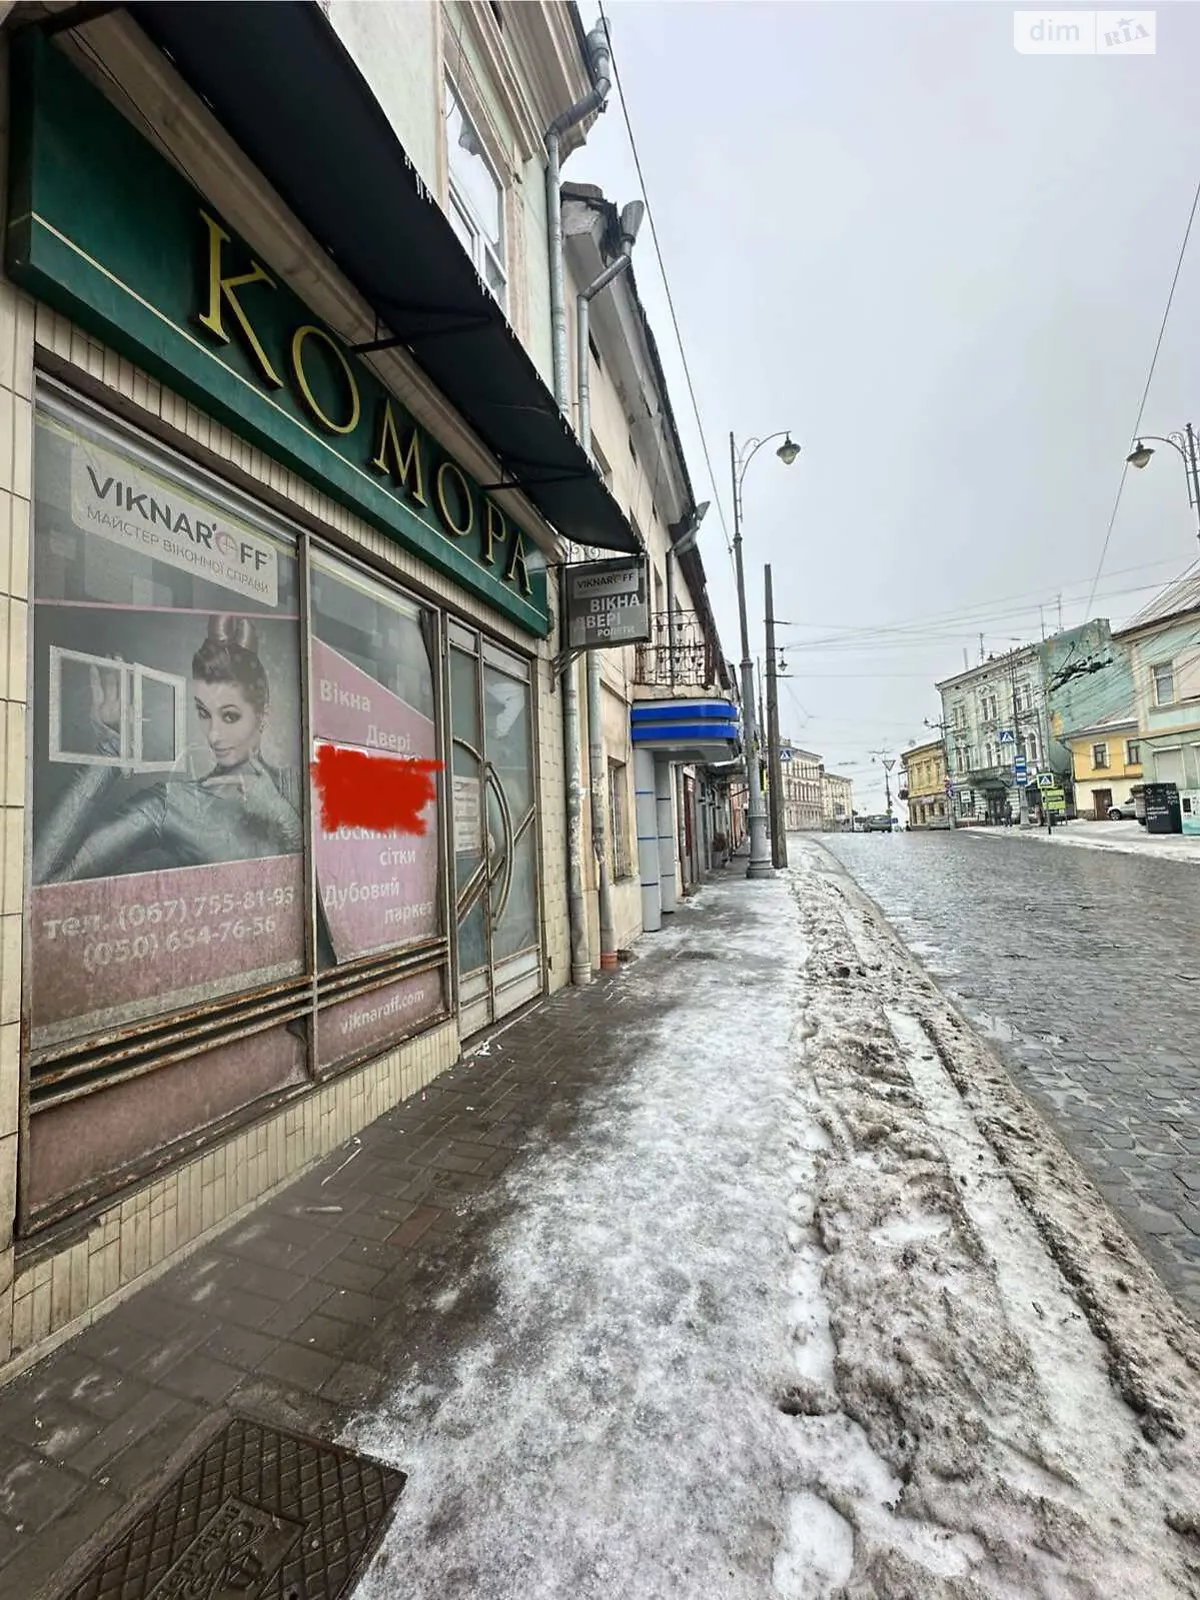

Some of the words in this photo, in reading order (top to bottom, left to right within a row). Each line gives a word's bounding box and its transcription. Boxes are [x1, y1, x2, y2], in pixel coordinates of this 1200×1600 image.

[198, 207, 534, 598] КОМОРА
[87, 504, 160, 547] МАЙСТЕР
[162, 537, 227, 576] ВІКОННОЇ
[226, 566, 271, 594] СПРАВИ
[590, 593, 640, 613] ВІКНА
[320, 679, 371, 713] Вікна
[365, 724, 411, 752] Двері
[379, 847, 416, 867] сітки
[323, 877, 400, 910] Дубовий
[119, 898, 188, 931] (067)
[384, 901, 433, 925] паркет
[83, 934, 158, 973] (050)
[166, 916, 277, 952] 654-76-56
[340, 989, 425, 1034] viknaroff.com
